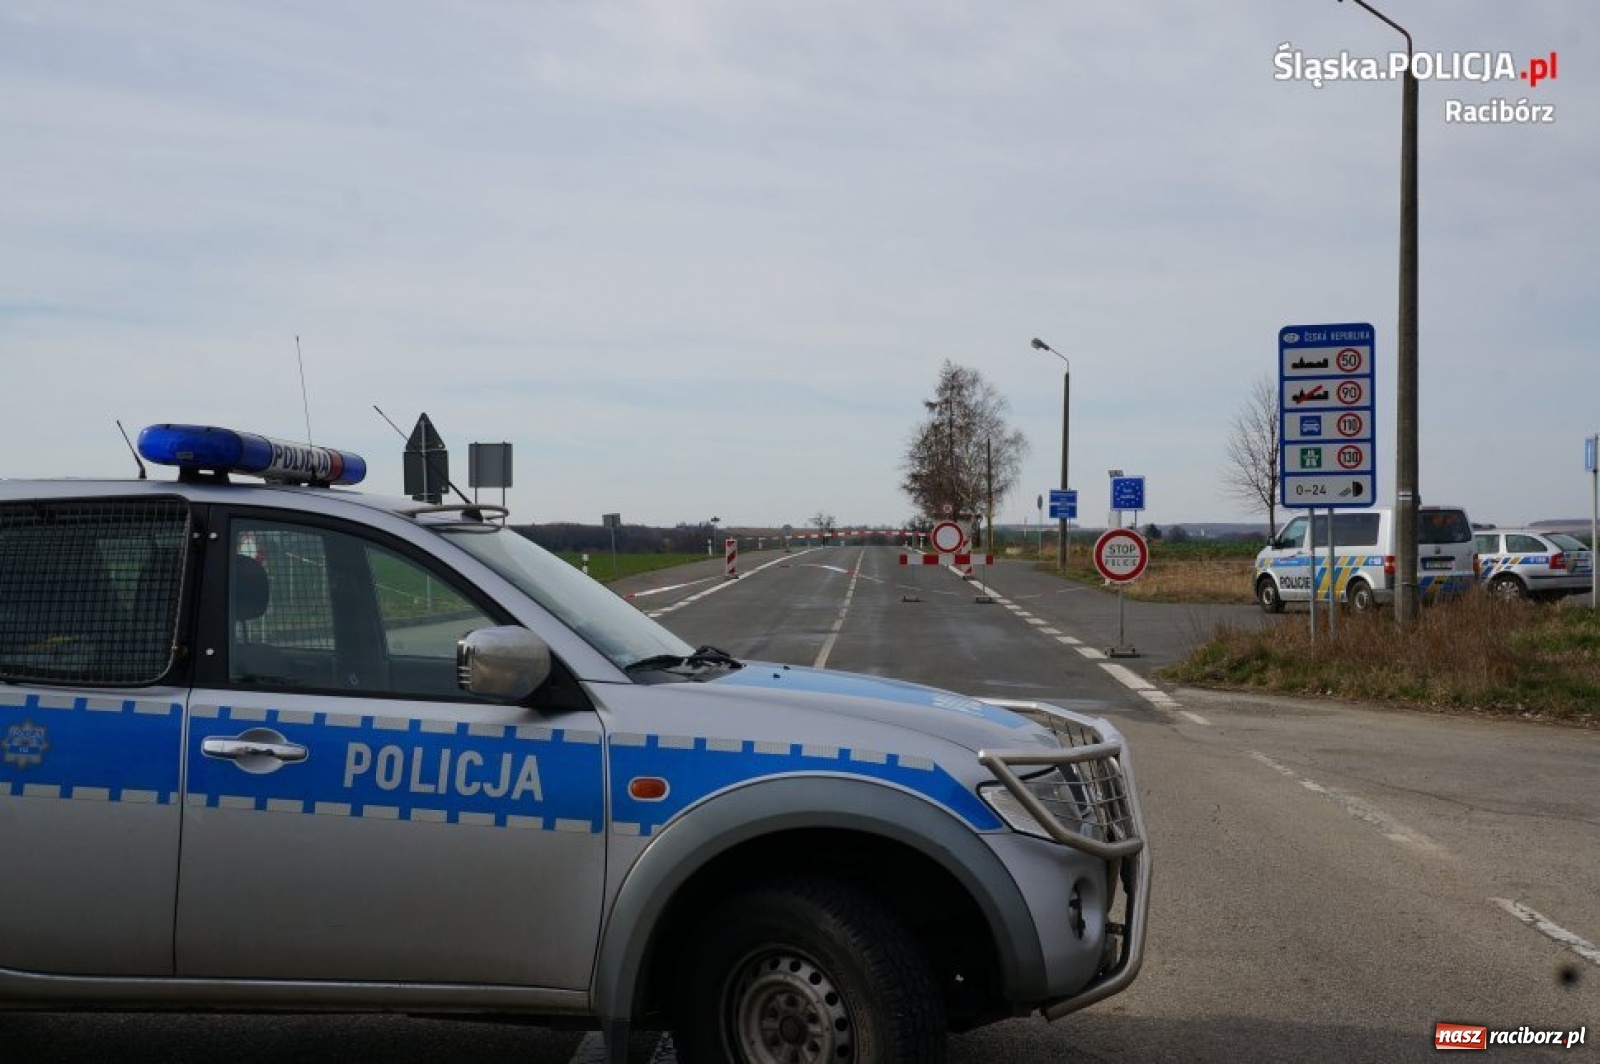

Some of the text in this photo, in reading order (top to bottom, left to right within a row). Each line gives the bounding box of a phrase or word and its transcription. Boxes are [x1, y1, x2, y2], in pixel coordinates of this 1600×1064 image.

[1342, 354, 1357, 367] 50
[1342, 387, 1357, 399] 90
[1342, 418, 1358, 431] 110
[272, 443, 330, 474] POLICJA
[1342, 451, 1359, 463] 130
[1107, 544, 1136, 555] STOP
[1279, 576, 1311, 590] POLICIE
[343, 741, 544, 802] POLICJA
